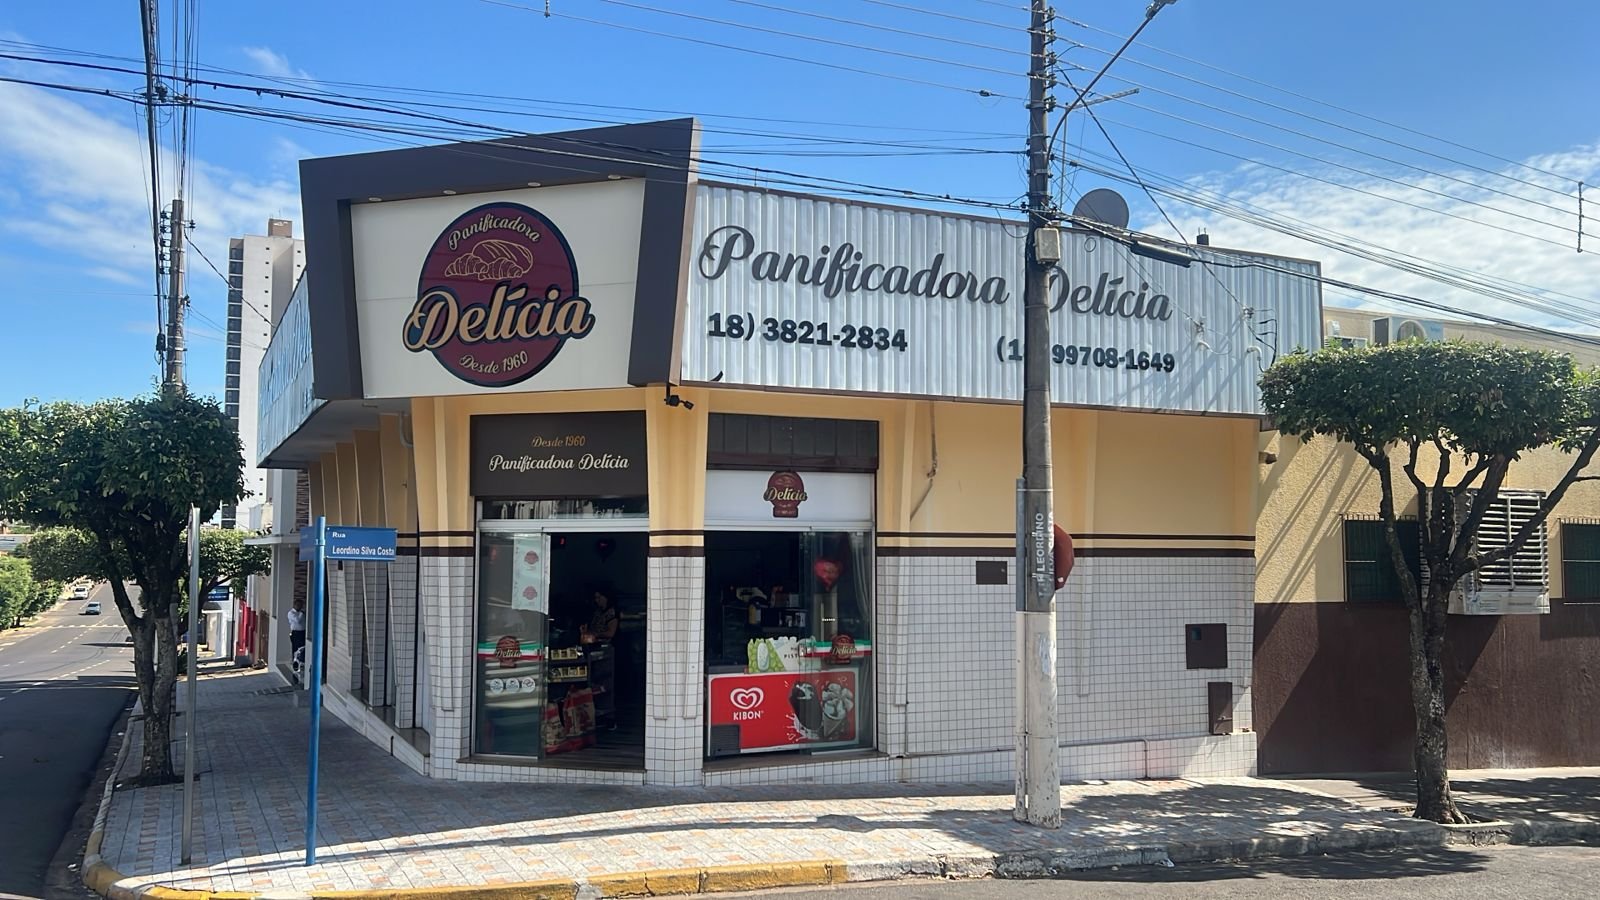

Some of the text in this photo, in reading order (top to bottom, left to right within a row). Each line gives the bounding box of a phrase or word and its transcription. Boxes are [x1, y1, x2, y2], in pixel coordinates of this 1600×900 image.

[448, 213, 540, 251] Panificadora
[699, 225, 1010, 304] Panificadora
[403, 284, 593, 350] Delícia
[708, 312, 908, 352] 18) 3821-2834
[459, 350, 528, 374] Desde 1960
[1052, 344, 1175, 373] 99708-1649
[532, 435, 586, 448] Desde 1960
[489, 453, 629, 472] Panificadora Delícia
[764, 487, 806, 501] Delícia
[361, 546, 376, 555] Silva
[377, 546, 395, 556] Costa
[1035, 513, 1046, 572] LEORDINO
[733, 711, 761, 720] KIBON
